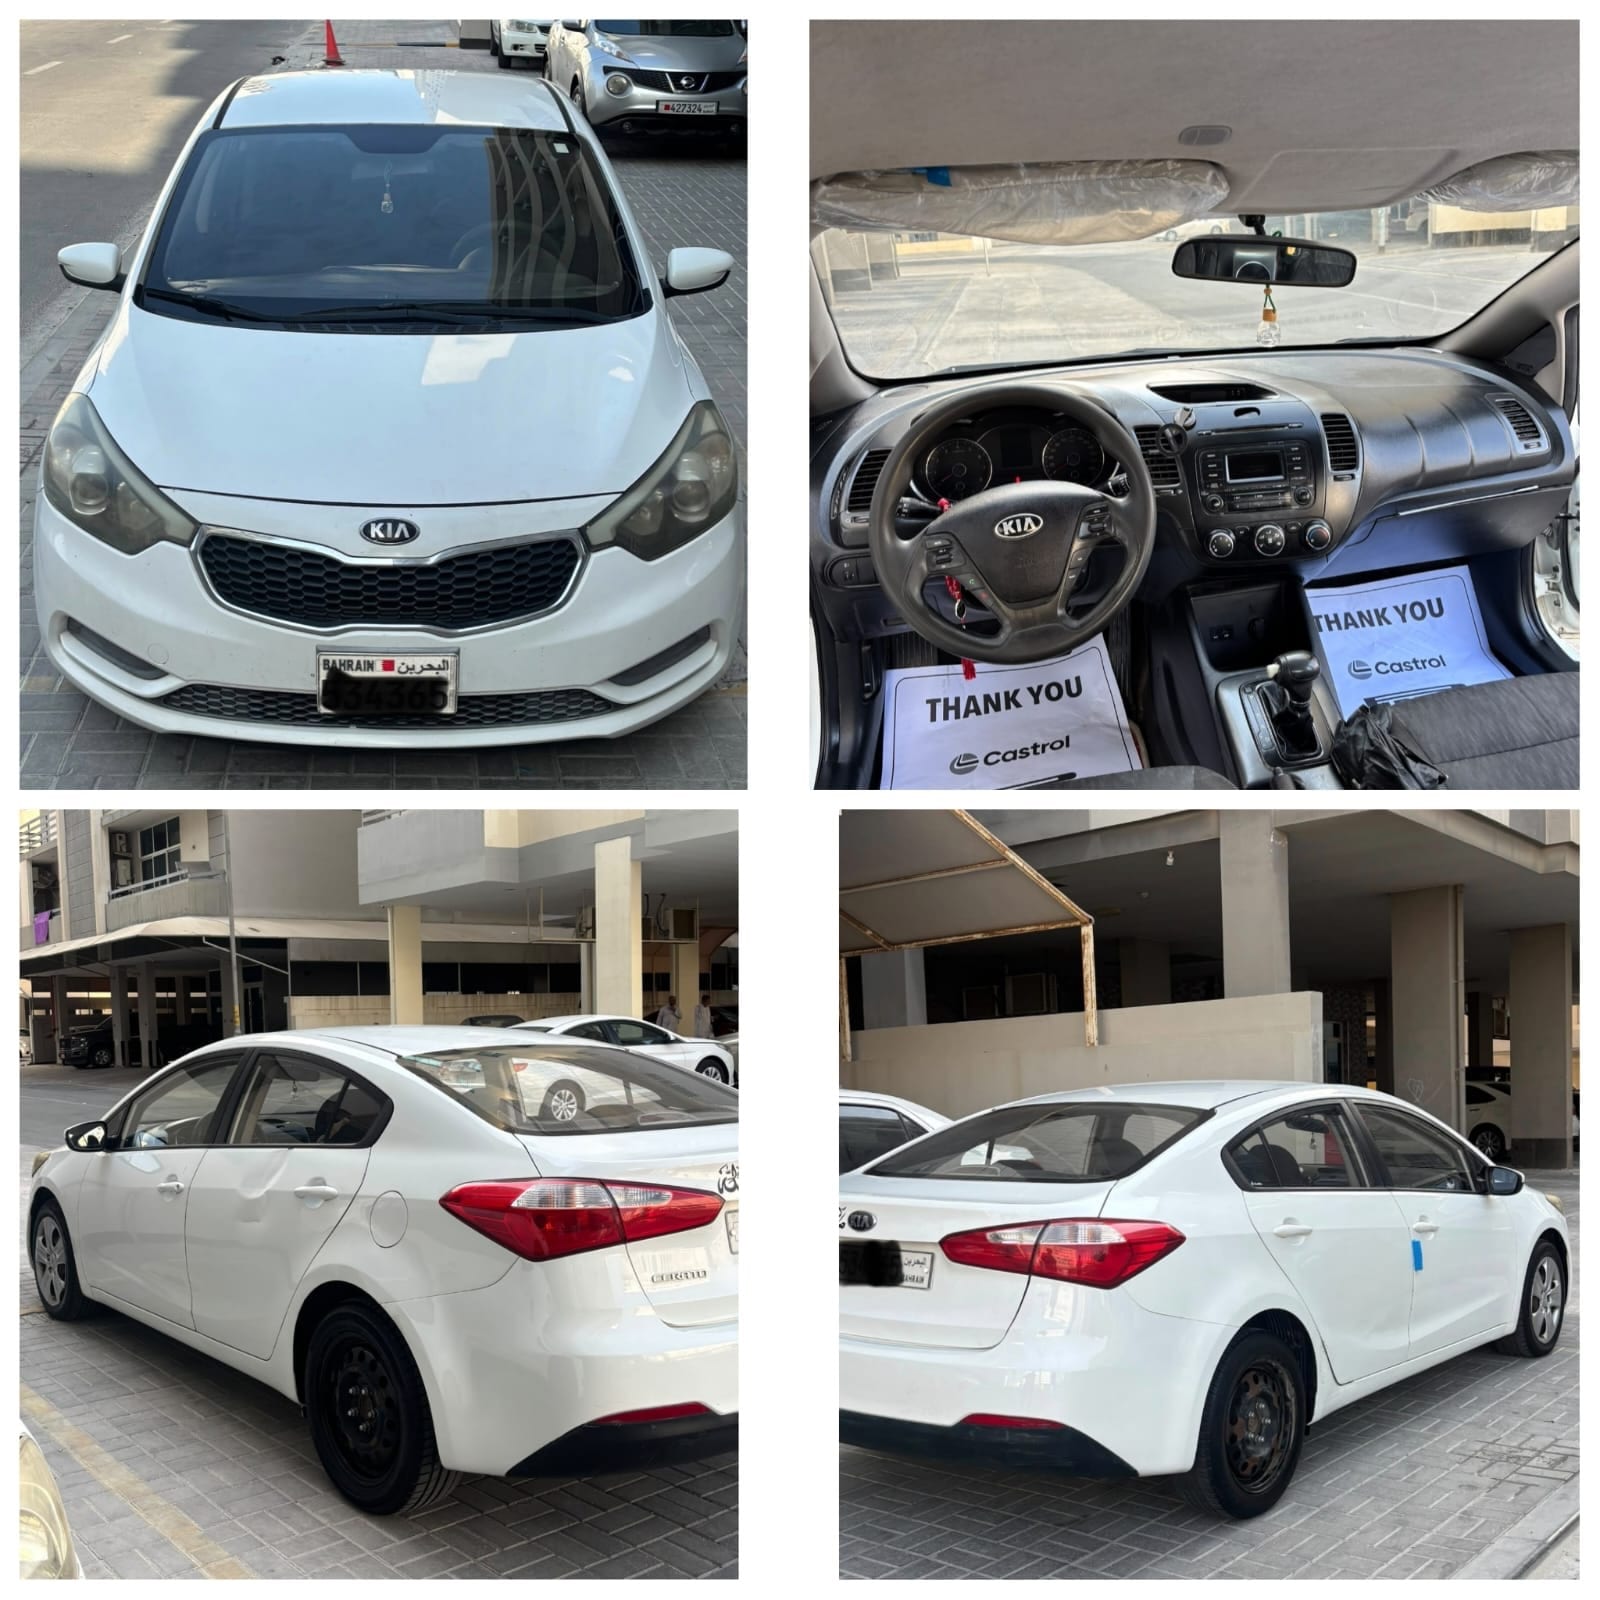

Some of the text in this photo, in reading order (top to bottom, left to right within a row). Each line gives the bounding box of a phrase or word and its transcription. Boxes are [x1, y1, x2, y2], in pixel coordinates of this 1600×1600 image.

[671, 103, 702, 113] 427324
[370, 522, 410, 538] KIA
[1002, 515, 1037, 536] KIA
[1313, 597, 1444, 633] THANK YOU
[322, 658, 374, 672] BAHRAIN
[397, 658, 450, 674] البحرين
[1375, 655, 1447, 675] Castrol
[926, 675, 1083, 723] THANK YOU
[983, 735, 1070, 766] Castrol
[850, 1214, 870, 1228] KIA
[651, 1269, 707, 1283] CERATO
[903, 1274, 925, 1284] AHRAIN
